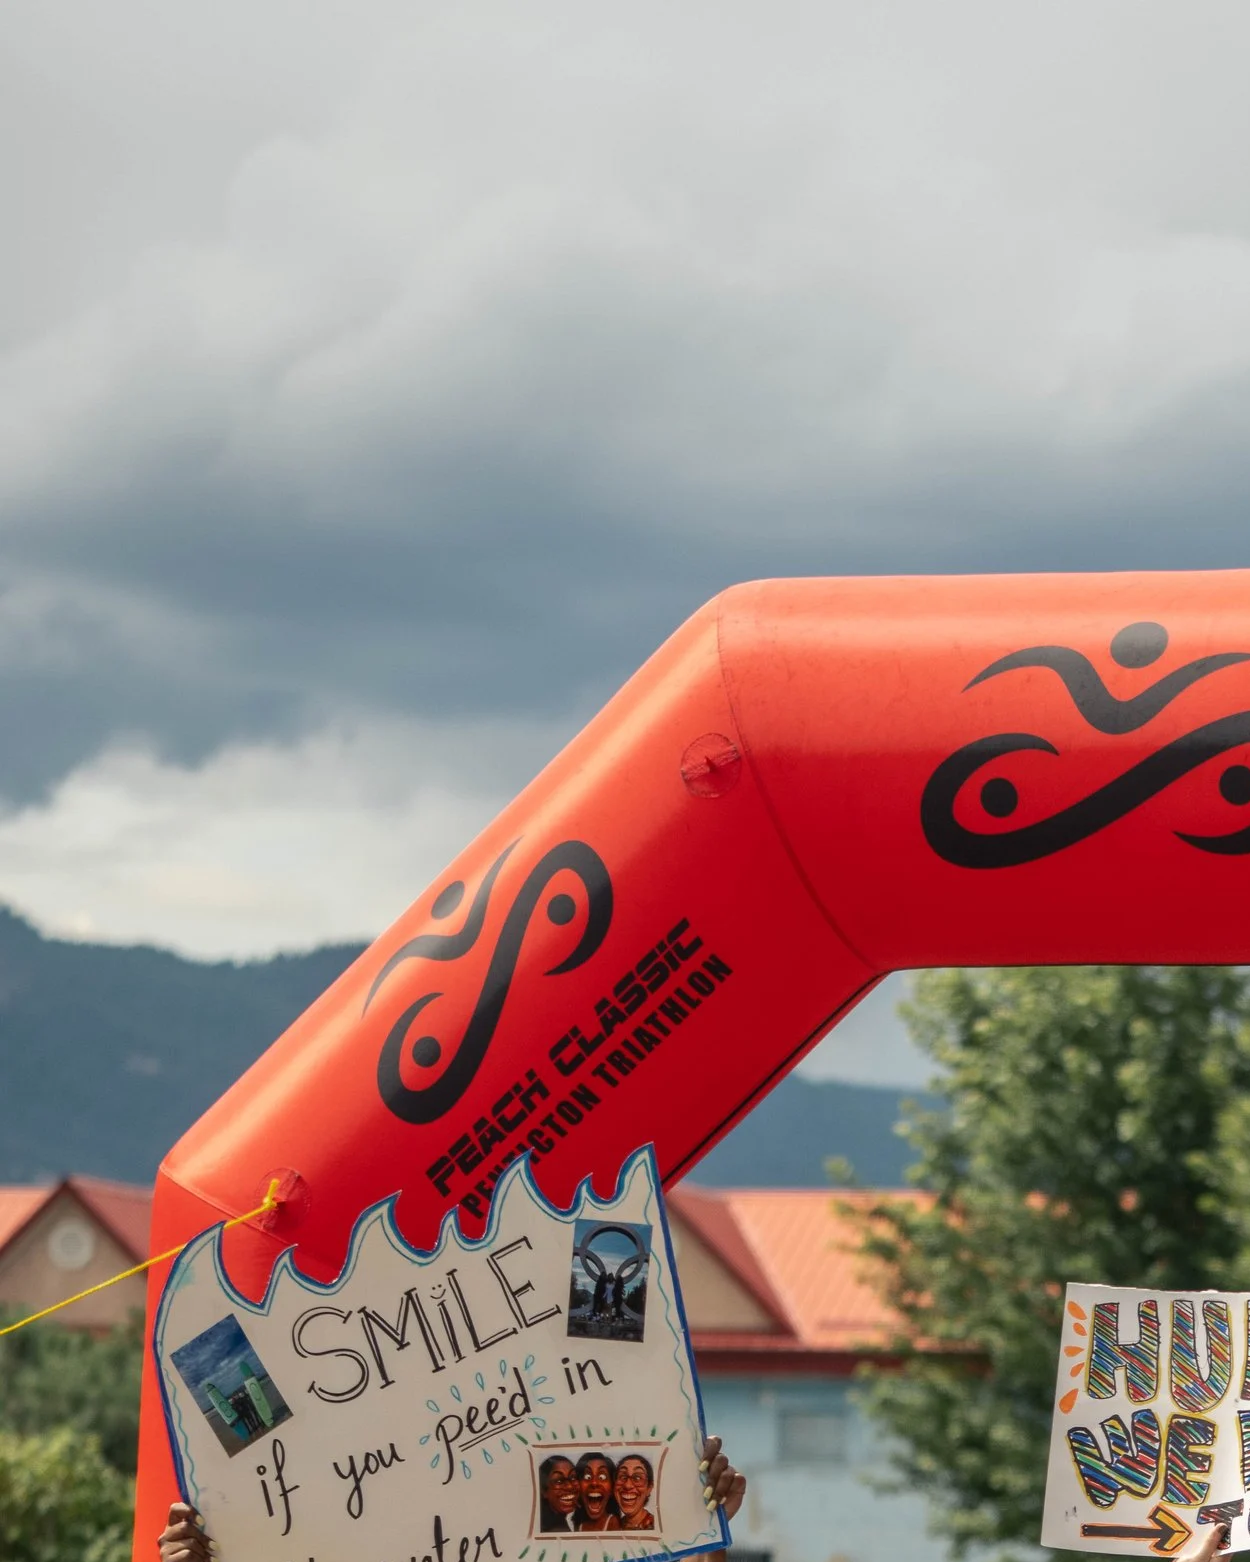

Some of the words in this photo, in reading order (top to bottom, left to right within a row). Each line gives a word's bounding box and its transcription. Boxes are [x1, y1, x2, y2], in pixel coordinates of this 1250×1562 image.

[425, 1068, 551, 1197] PEACH
[549, 917, 704, 1077] CLASSIC
[591, 954, 733, 1088] TRIATHLON
[256, 1438, 300, 1536] if
[334, 1442, 404, 1519] you
[561, 1357, 613, 1395] in
[1067, 1409, 1216, 1511] WE
